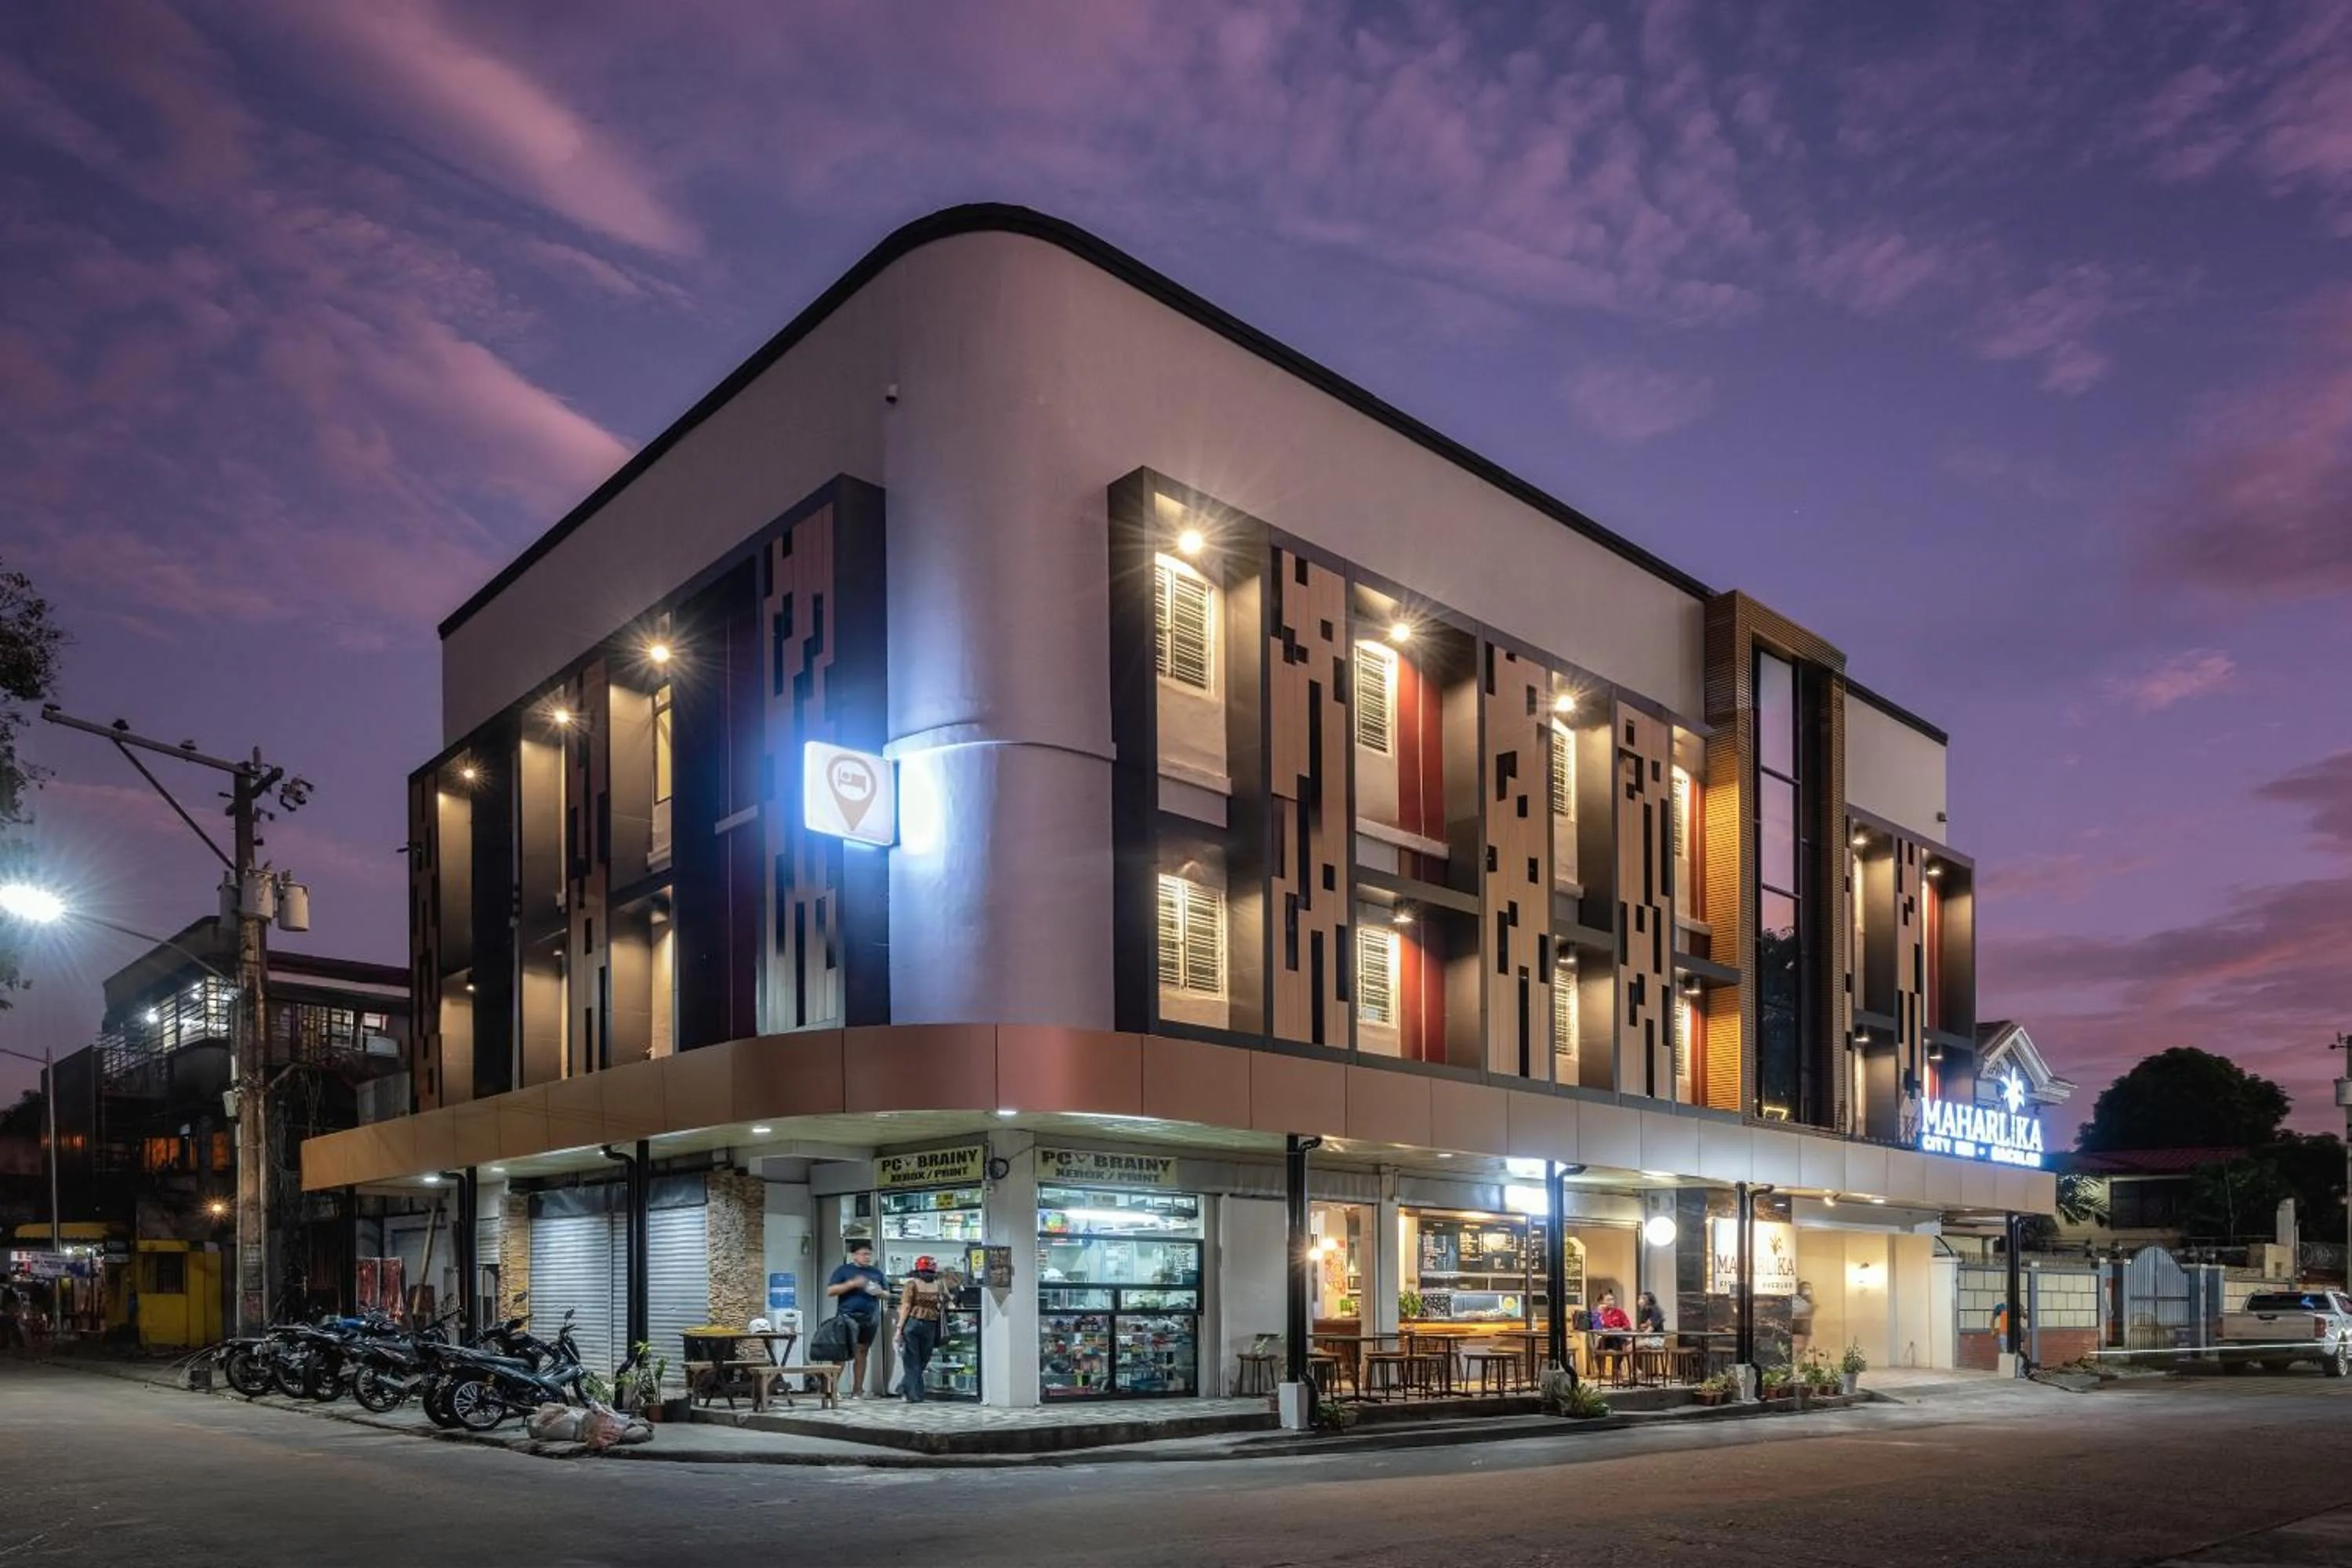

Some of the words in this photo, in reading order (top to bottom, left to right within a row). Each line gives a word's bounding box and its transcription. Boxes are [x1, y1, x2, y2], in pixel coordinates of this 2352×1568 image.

[1922, 1097, 2044, 1152] MAHARLIKA
[881, 1158, 902, 1172] PC
[916, 1149, 979, 1168] BRAINY
[1041, 1150, 1072, 1167] PC
[1094, 1153, 1171, 1172] BRAINY
